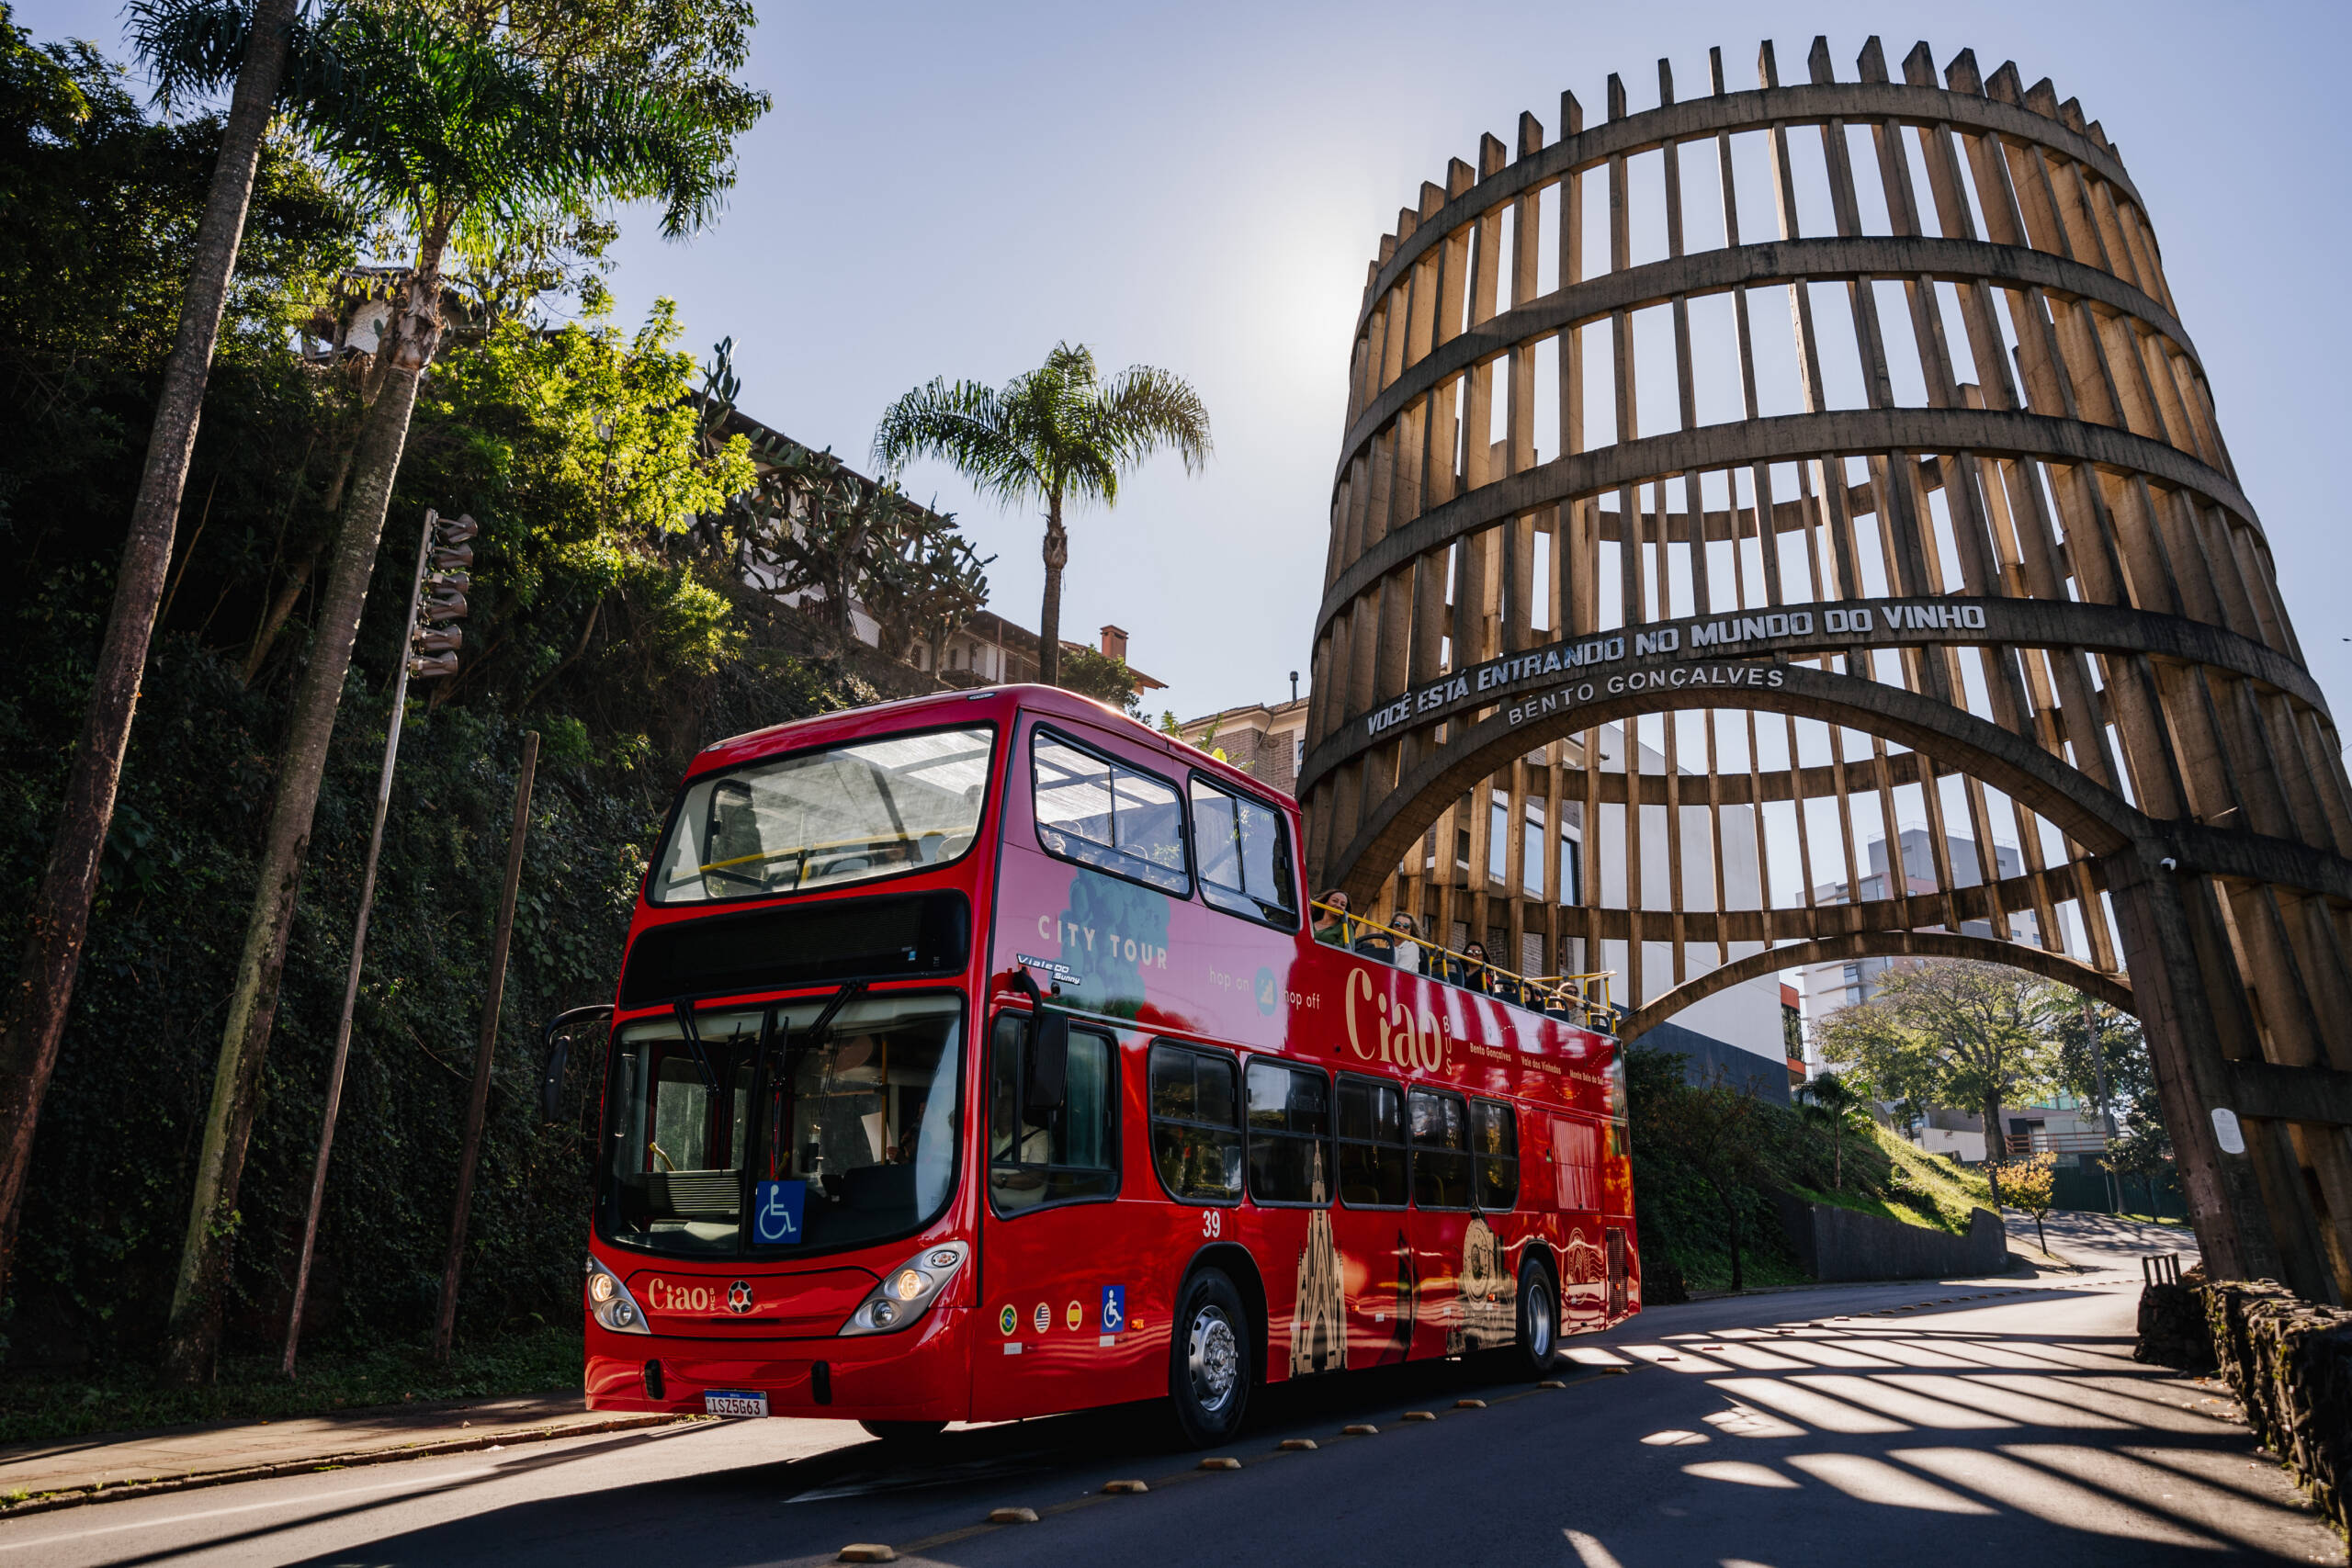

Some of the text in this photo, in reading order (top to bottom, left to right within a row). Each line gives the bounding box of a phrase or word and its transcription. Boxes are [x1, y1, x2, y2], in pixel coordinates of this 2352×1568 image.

[1367, 605, 1986, 736] VOCÊ ESTÁ ENTRANDO NO MUNDO DO VINHO
[1509, 667, 1783, 726] BENTO GONÇALVES
[1038, 915, 1167, 969] CITY TOUR
[1017, 955, 1053, 969] Viale
[1054, 973, 1080, 984] Sunny
[1209, 964, 1230, 992] hop
[1236, 977, 1250, 991] on
[1306, 993, 1320, 1010] off
[1345, 967, 1442, 1073] Ciao
[1470, 1042, 1511, 1062] Bento Gonçalves
[1202, 1210, 1220, 1237] 39
[648, 1278, 707, 1310] Ciao
[711, 1399, 761, 1415] ISZ5G63
